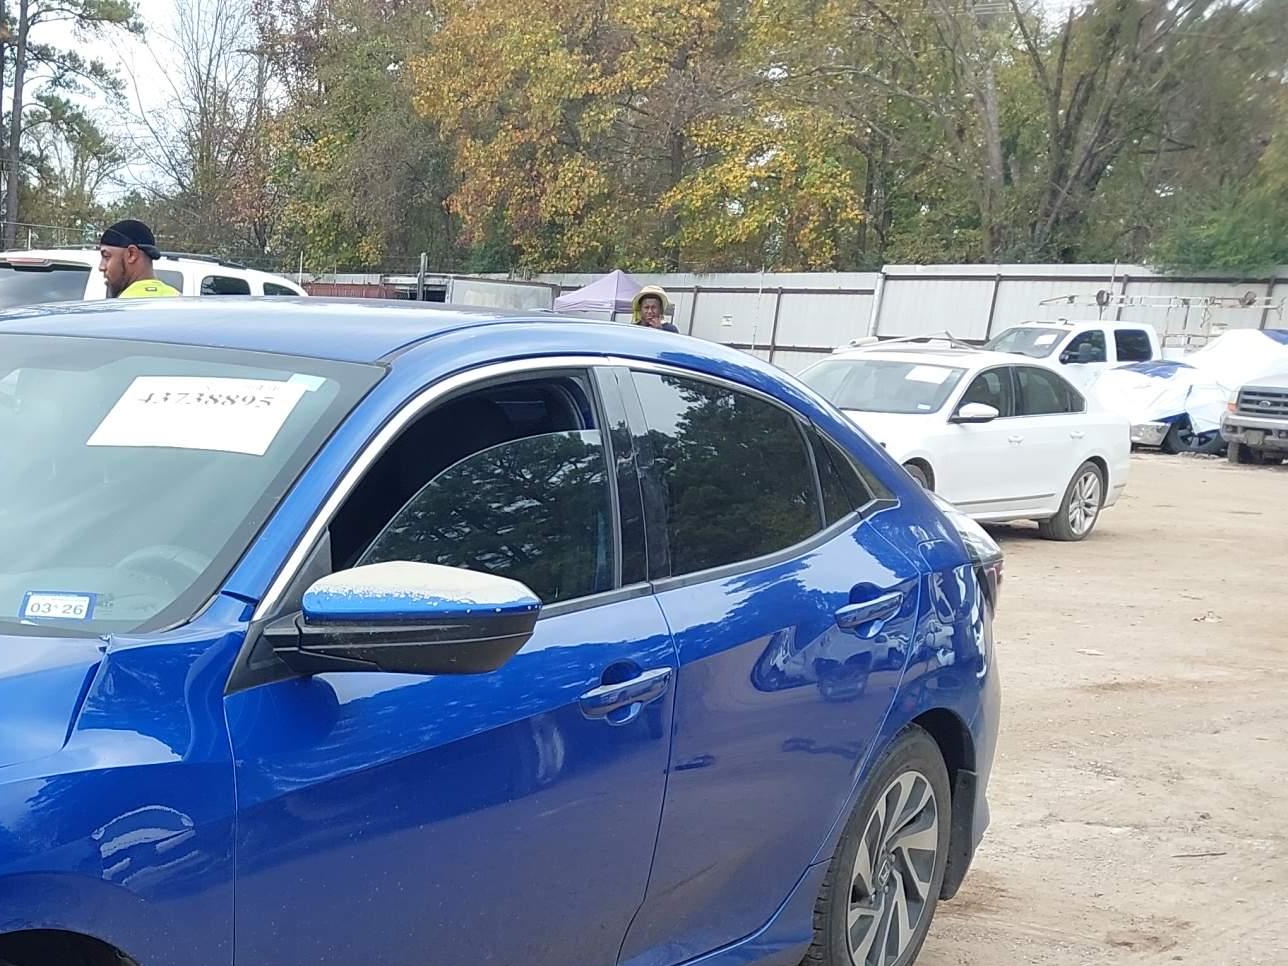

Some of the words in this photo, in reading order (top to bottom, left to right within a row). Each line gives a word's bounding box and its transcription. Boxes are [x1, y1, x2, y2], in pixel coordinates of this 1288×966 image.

[139, 392, 275, 408] 43738895
[30, 602, 52, 614] 03
[61, 604, 84, 615] 26
